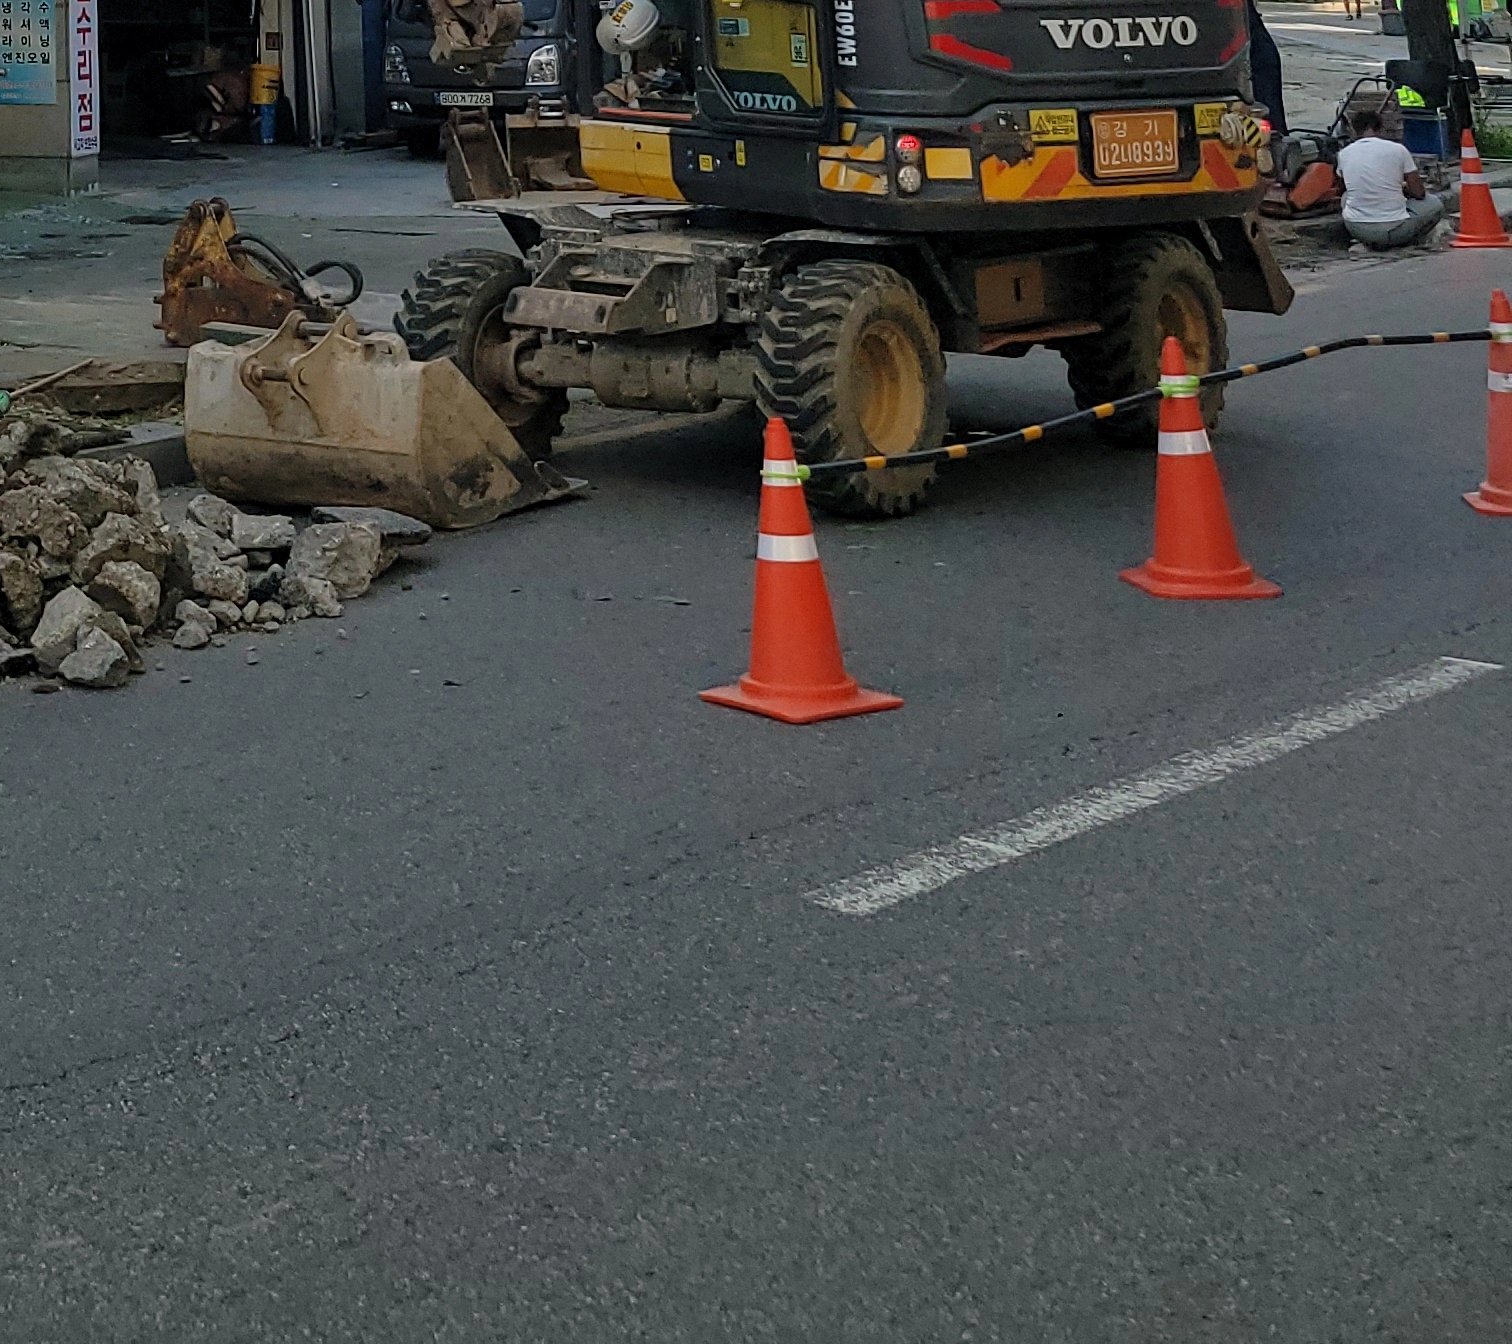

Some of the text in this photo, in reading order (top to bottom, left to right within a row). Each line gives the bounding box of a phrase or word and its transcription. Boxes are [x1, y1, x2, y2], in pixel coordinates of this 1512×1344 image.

[834, 0, 858, 67] EW60E
[1040, 15, 1198, 50] VOLVO
[1, 51, 51, 65] 엔진오일
[1113, 120, 1160, 139] 경기
